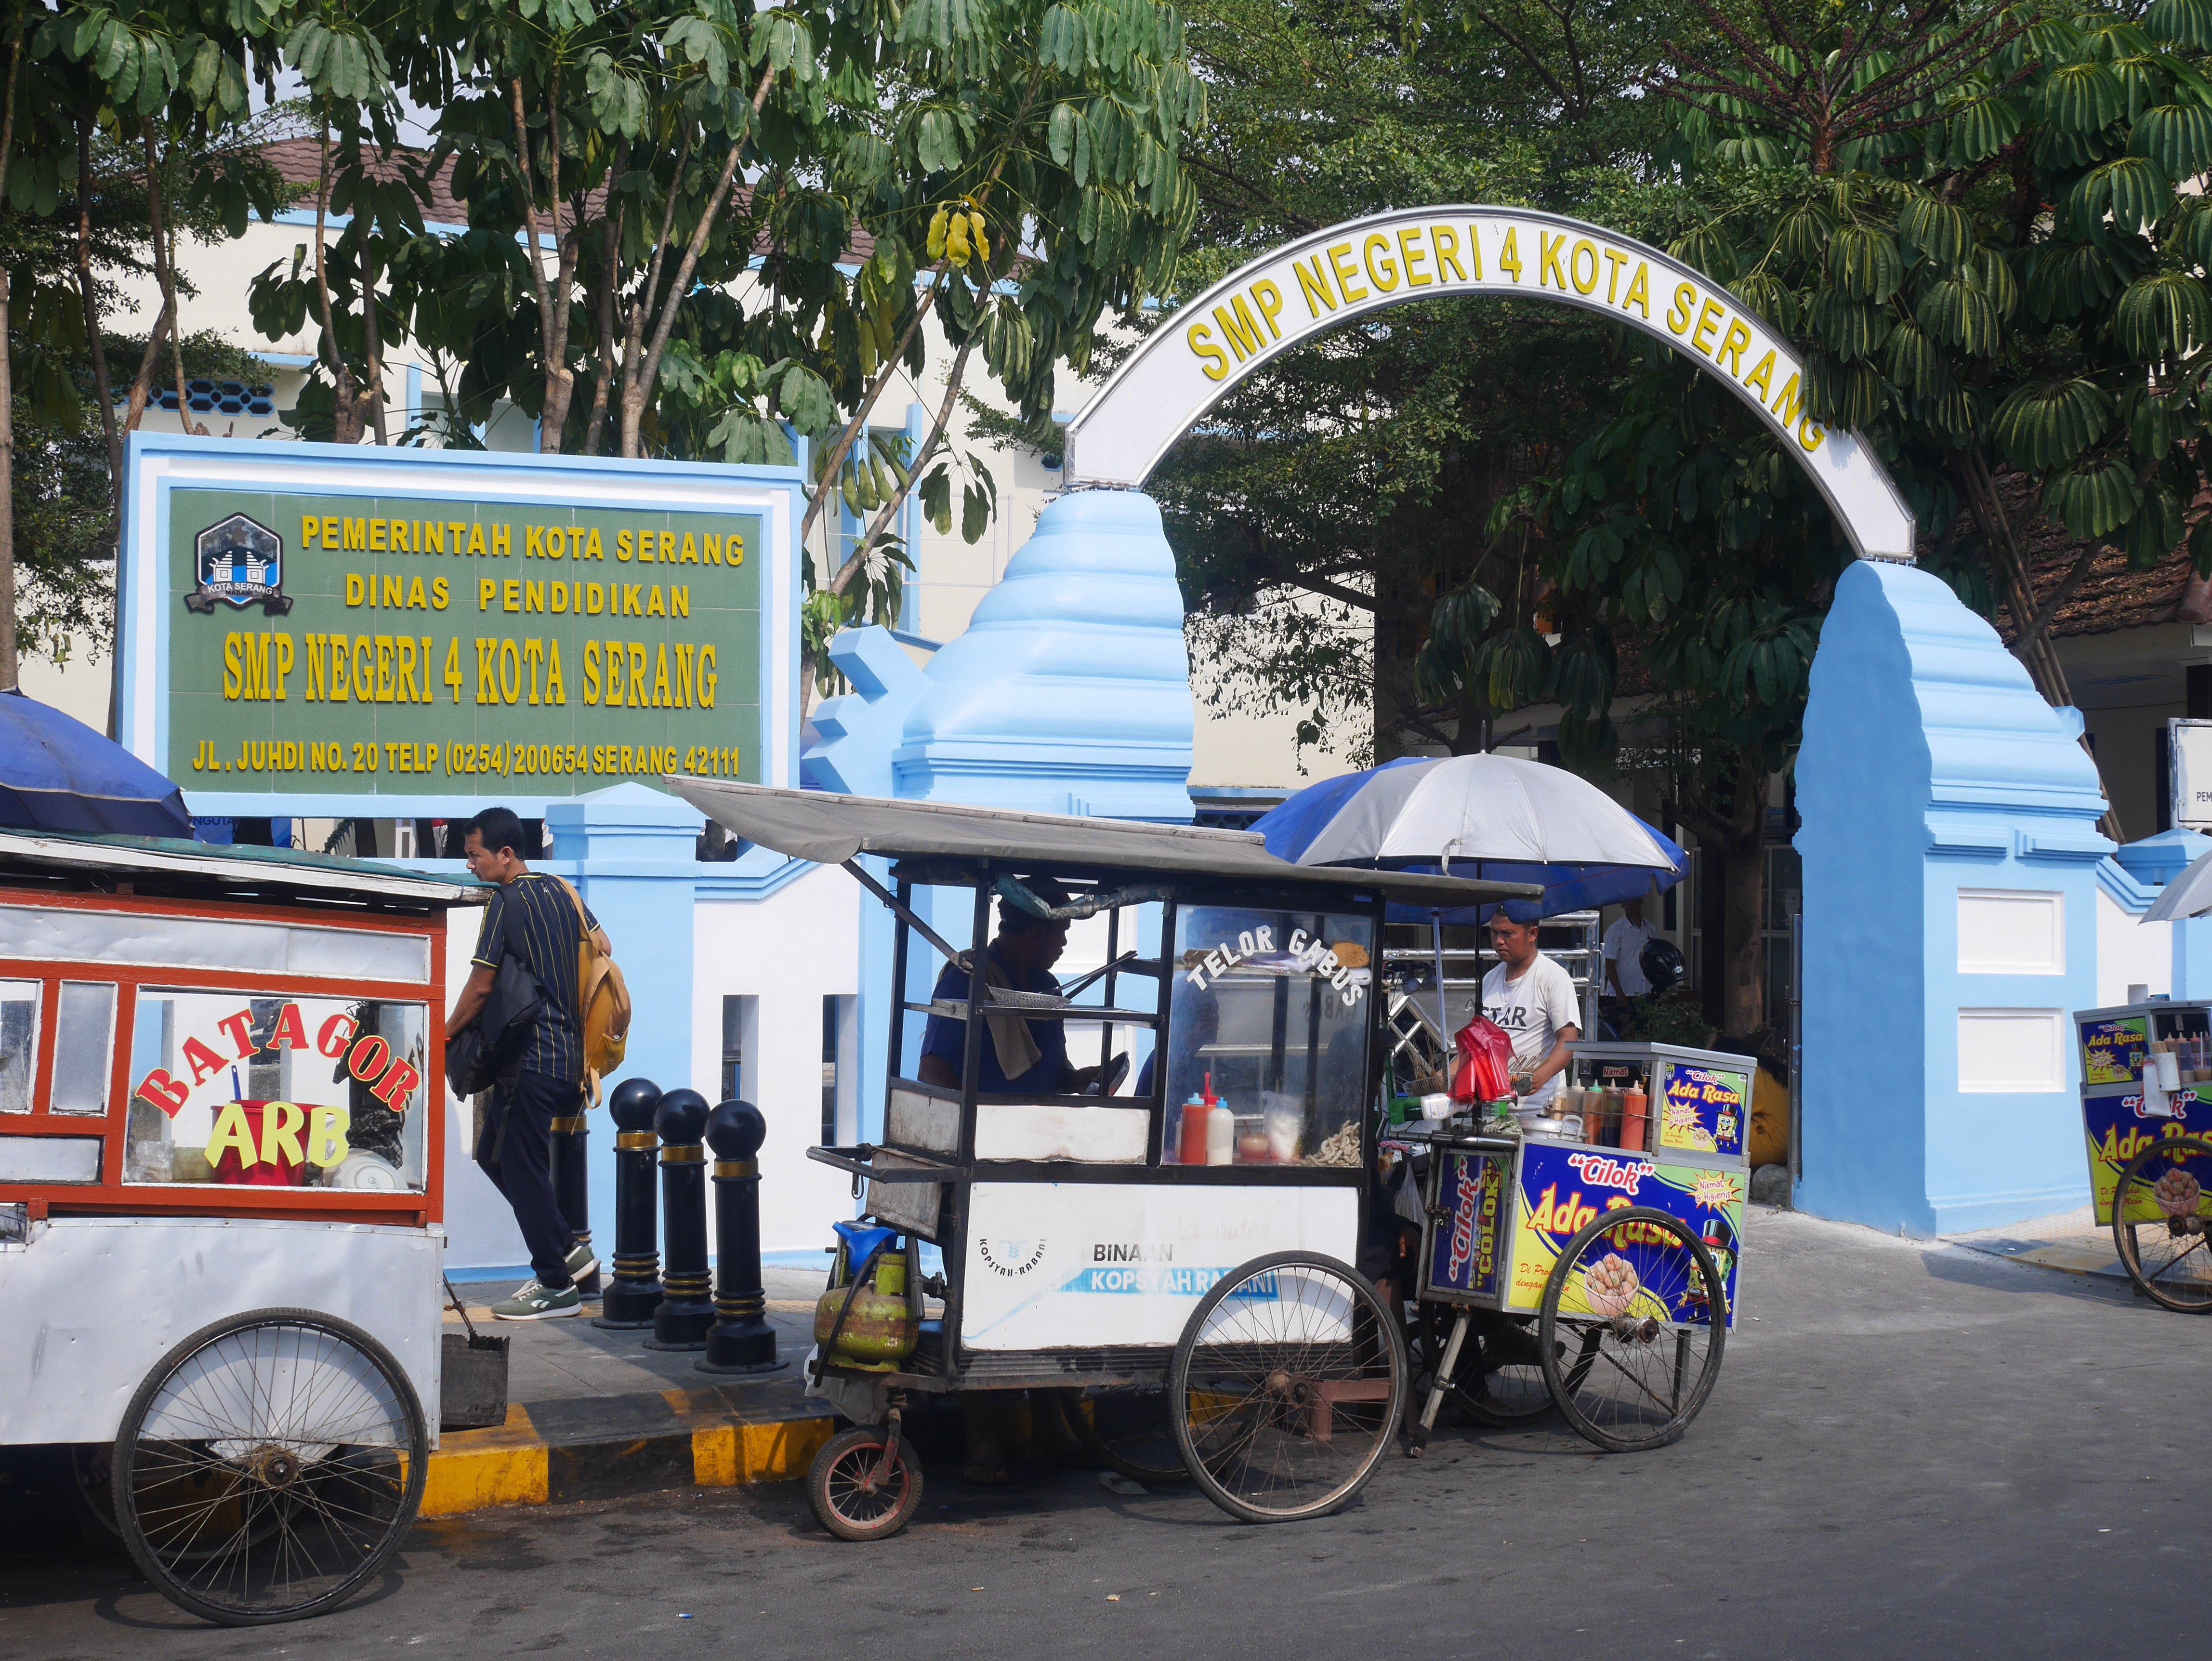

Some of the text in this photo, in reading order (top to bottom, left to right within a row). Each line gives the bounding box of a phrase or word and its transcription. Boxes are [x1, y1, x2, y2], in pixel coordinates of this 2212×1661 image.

[1188, 279, 1283, 381] SMP
[1294, 225, 1483, 317] NEGERI
[1501, 227, 1523, 282] 4
[1541, 231, 1650, 318] KOTA
[302, 516, 743, 566] PEMERINTAH KOTA SERANG
[208, 582, 273, 595] KOTA SERANG
[346, 574, 689, 617] DINAS PENDIDIKAN
[223, 632, 718, 709] SMP NEGERI 4 KOTA SERANG
[237, 741, 304, 771] JUHDI
[311, 742, 347, 771] NO.
[353, 743, 379, 771] 20
[385, 743, 439, 772] TELP
[592, 745, 677, 774] SERANG
[684, 747, 739, 775] 42111
[1186, 924, 1363, 1006] TELOR GABUS
[1483, 1006, 1527, 1027] TAR
[2087, 1032, 2145, 1047] Ada Rasa
[135, 1003, 420, 1120] BATAGOR
[1603, 1066, 1629, 1077] Nikmat
[1667, 1079, 1740, 1104] Ada Rasa
[1675, 1116, 1696, 1124] Higienis
[203, 1101, 350, 1169] ARB
[1700, 1180, 1725, 1190] Nikmat
[1526, 1182, 1598, 1234] Ada
[1696, 1191, 1731, 1203] & Higienis
[1520, 1263, 1532, 1273] Di
[1092, 1270, 1273, 1292] KOPSYAH RAANI
[1515, 1278, 1543, 1291] dengan
